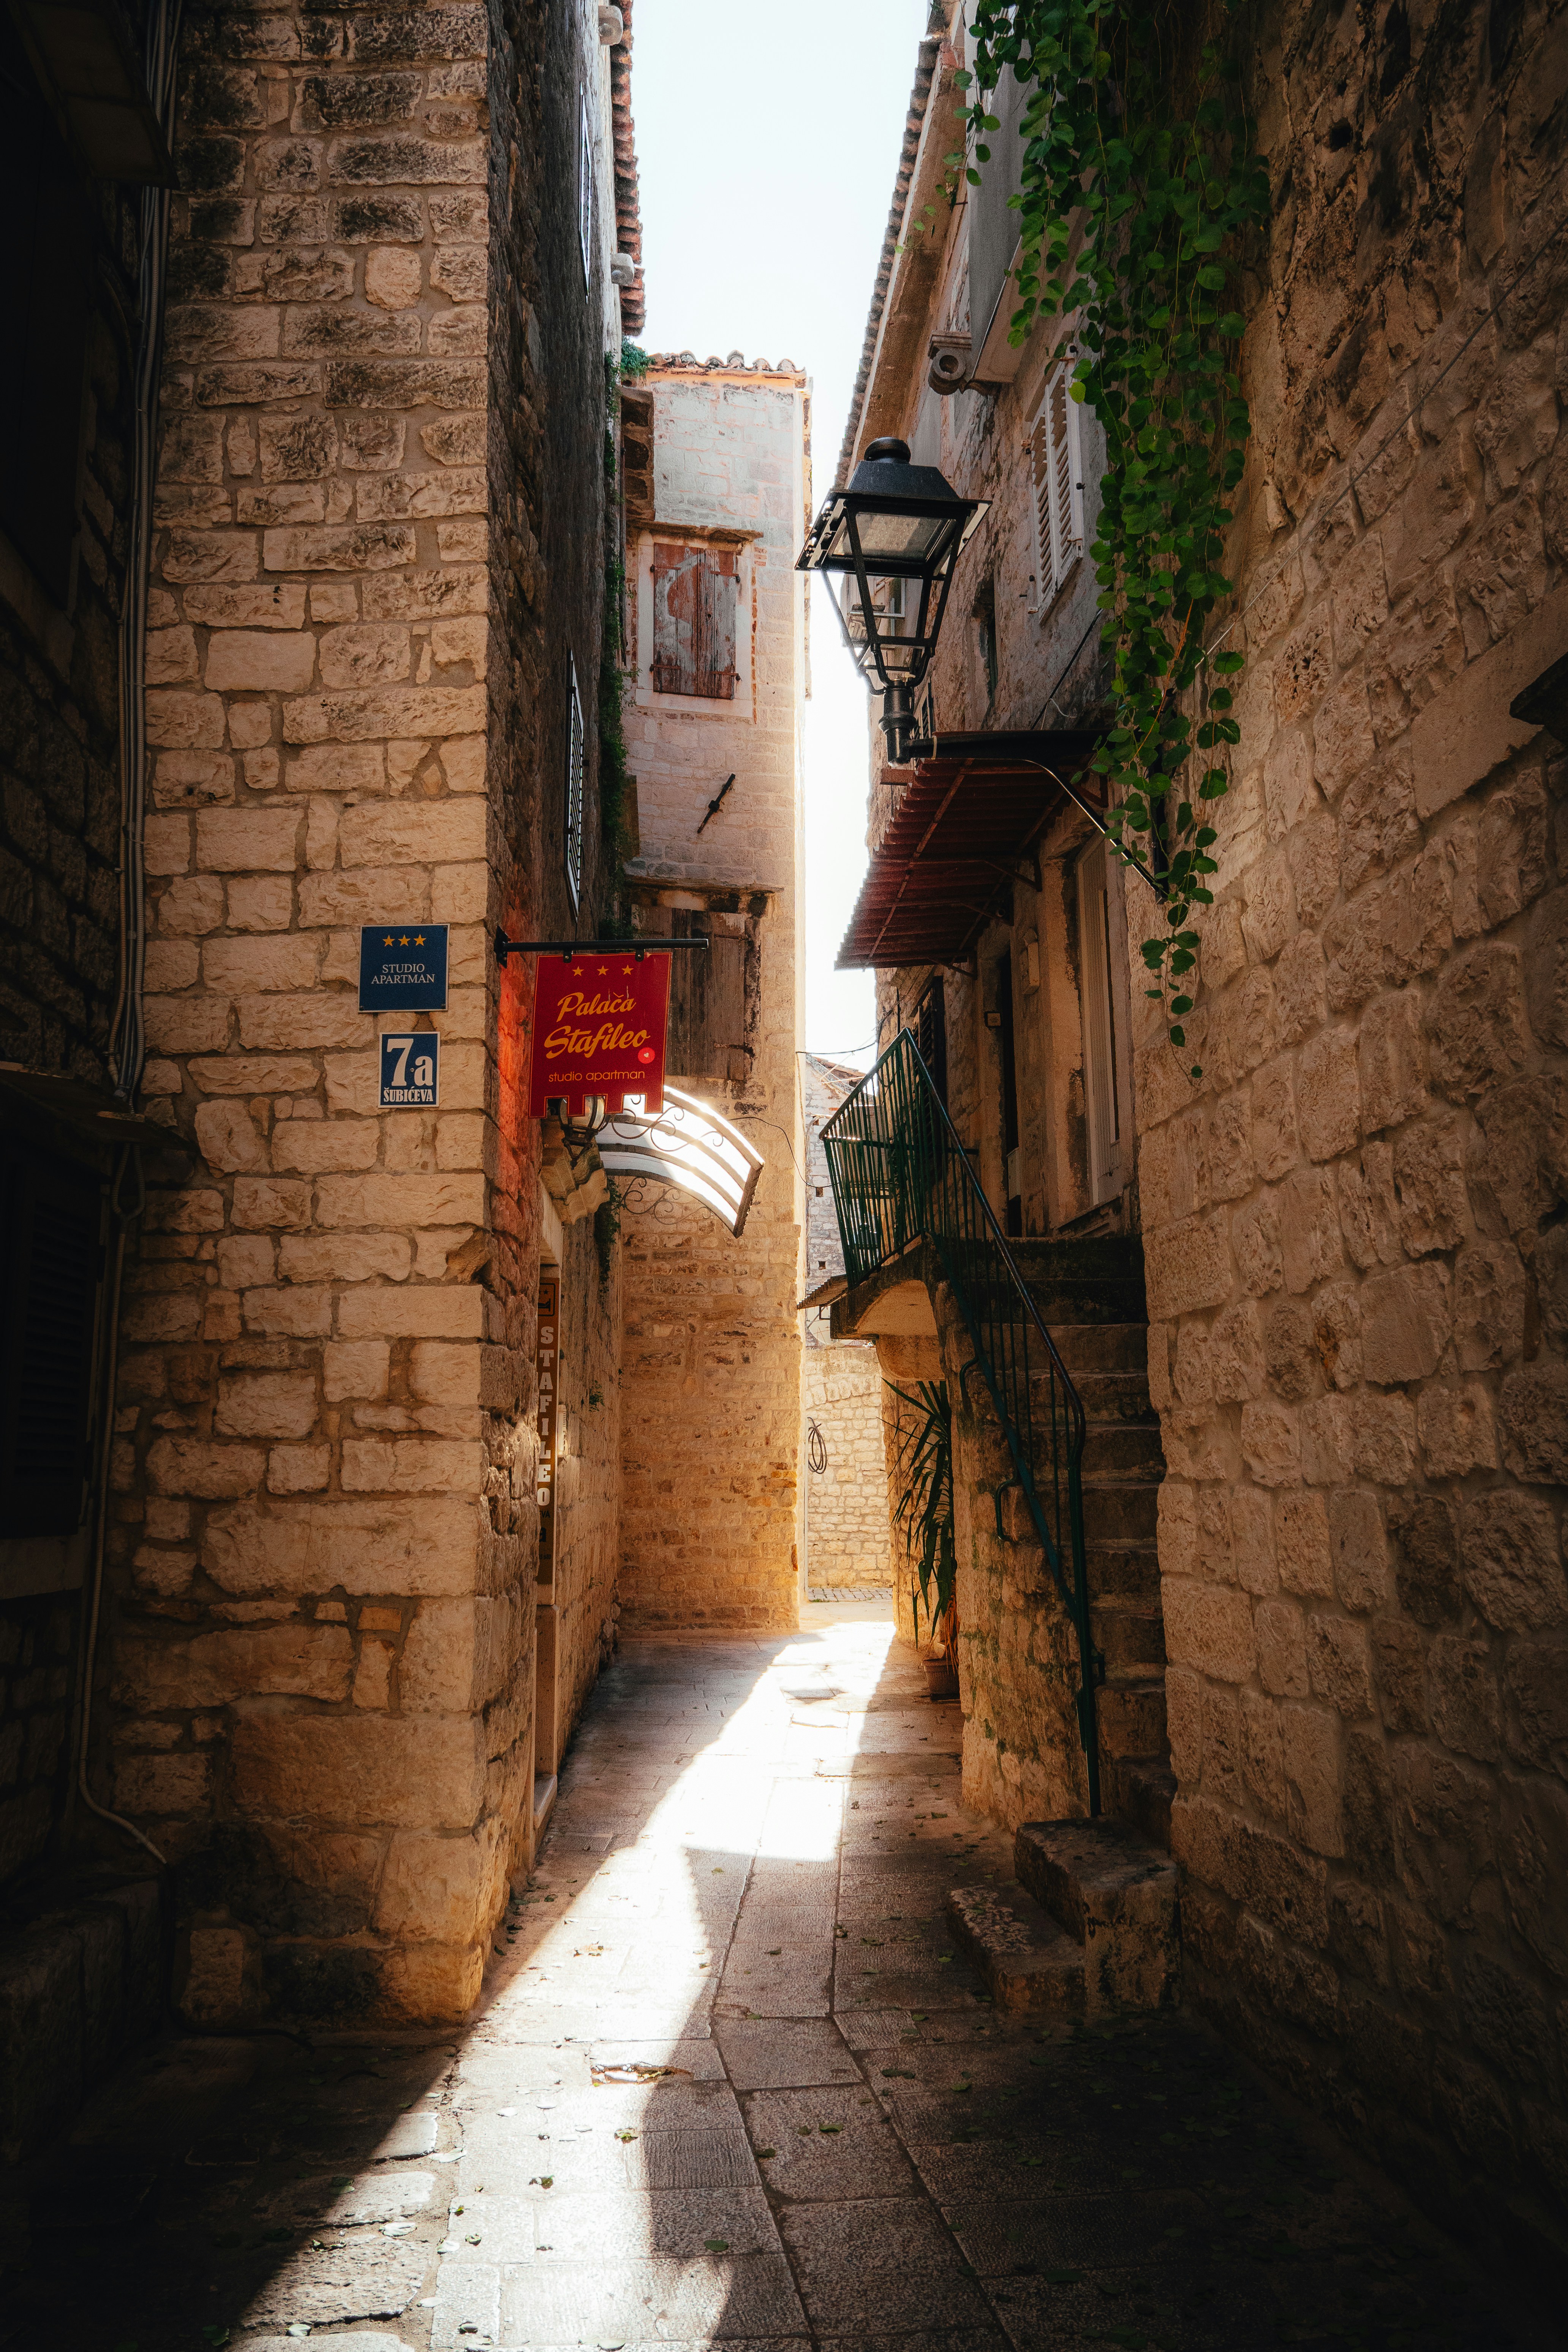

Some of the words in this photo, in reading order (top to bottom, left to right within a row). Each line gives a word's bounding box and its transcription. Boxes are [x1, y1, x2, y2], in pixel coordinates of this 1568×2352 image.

[371, 974, 435, 984] APARTMAN
[382, 964, 425, 973] STUDIO
[556, 992, 636, 1022] Palača
[544, 1023, 650, 1059] Stafileo
[387, 1038, 433, 1086] 7a
[548, 1071, 582, 1082] studio
[586, 1070, 645, 1082] apartman
[383, 1086, 433, 1102] ŠUBIĆEVA
[537, 1326, 554, 1506] STAFILEO
